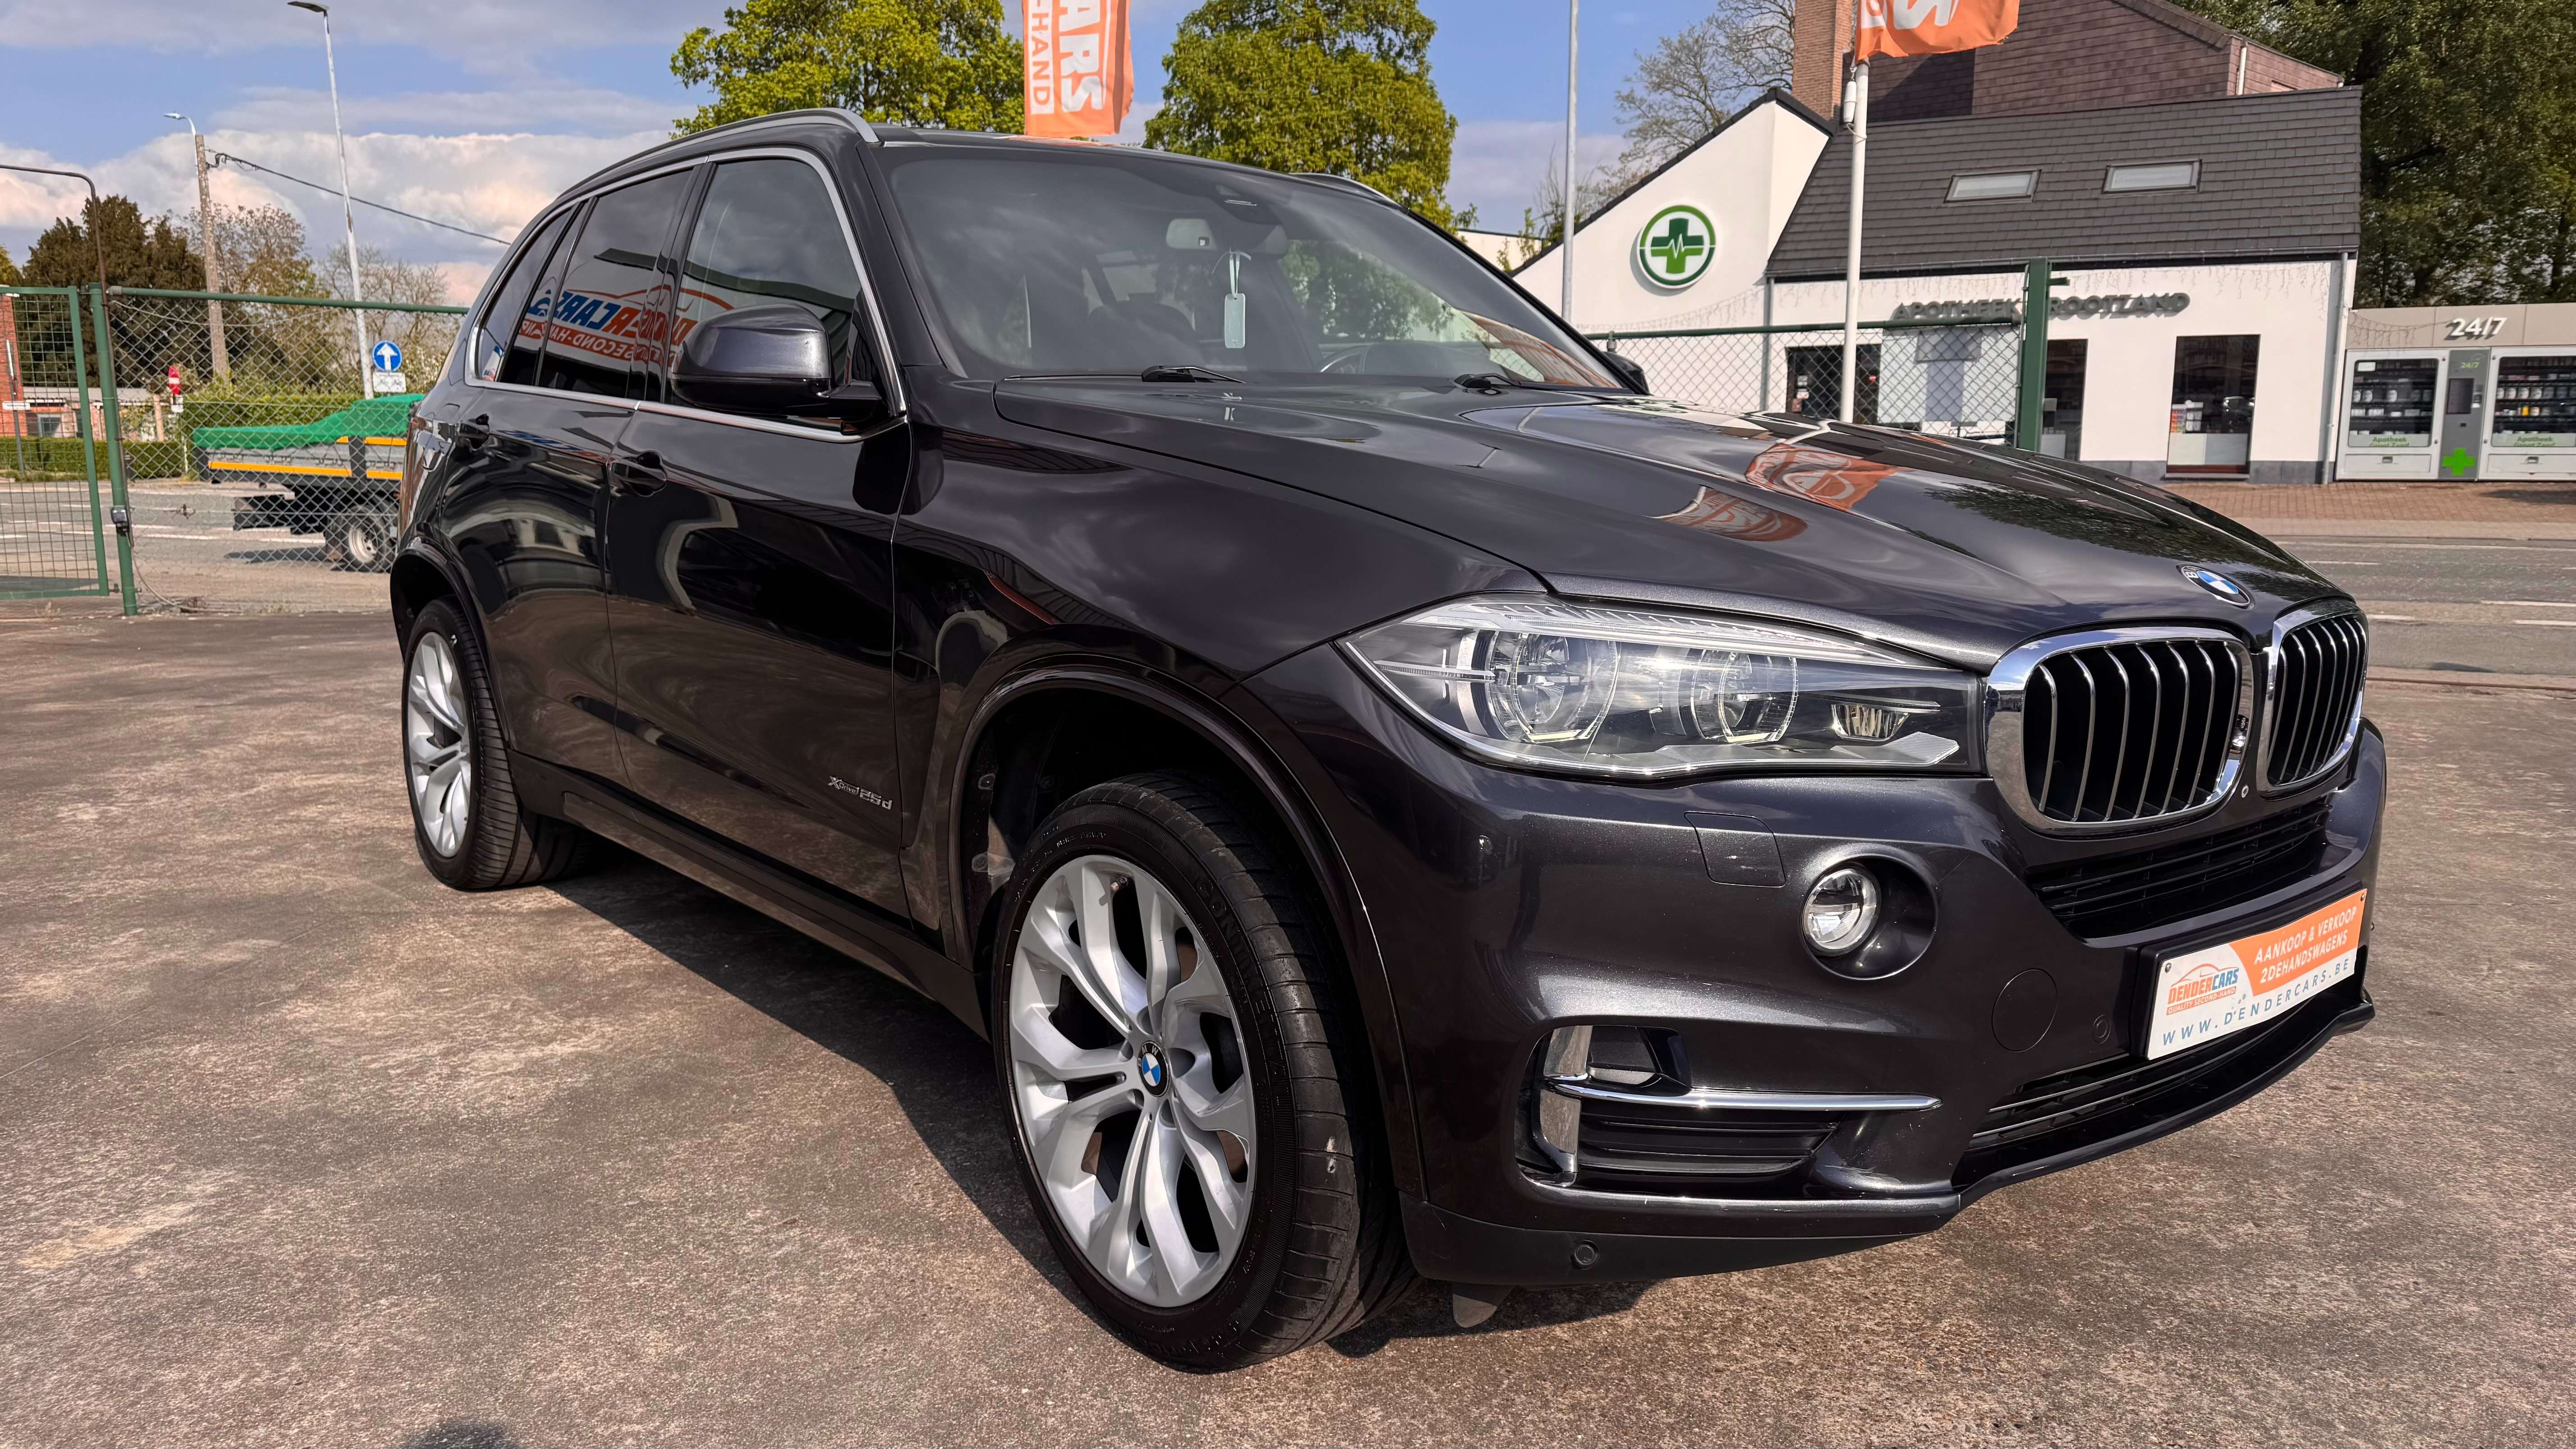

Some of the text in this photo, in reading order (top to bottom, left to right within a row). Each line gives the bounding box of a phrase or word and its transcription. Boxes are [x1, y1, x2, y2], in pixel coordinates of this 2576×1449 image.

[1893, 293, 2190, 320] APOTHEEK ROOTZAND
[2450, 317, 2507, 336] 24/7
[2254, 906, 2357, 965] AANKOOP & VERKOOP
[2260, 929, 2348, 984] 2DEHANDSWAGENS
[2168, 968, 2240, 1004] DENDERCARS
[2168, 987, 2235, 1014] QUALITY SECOND-HAND
[2163, 958, 2349, 1046] WWW.DENDERCARS.BE
[1138, 1044, 1159, 1067] BMW
